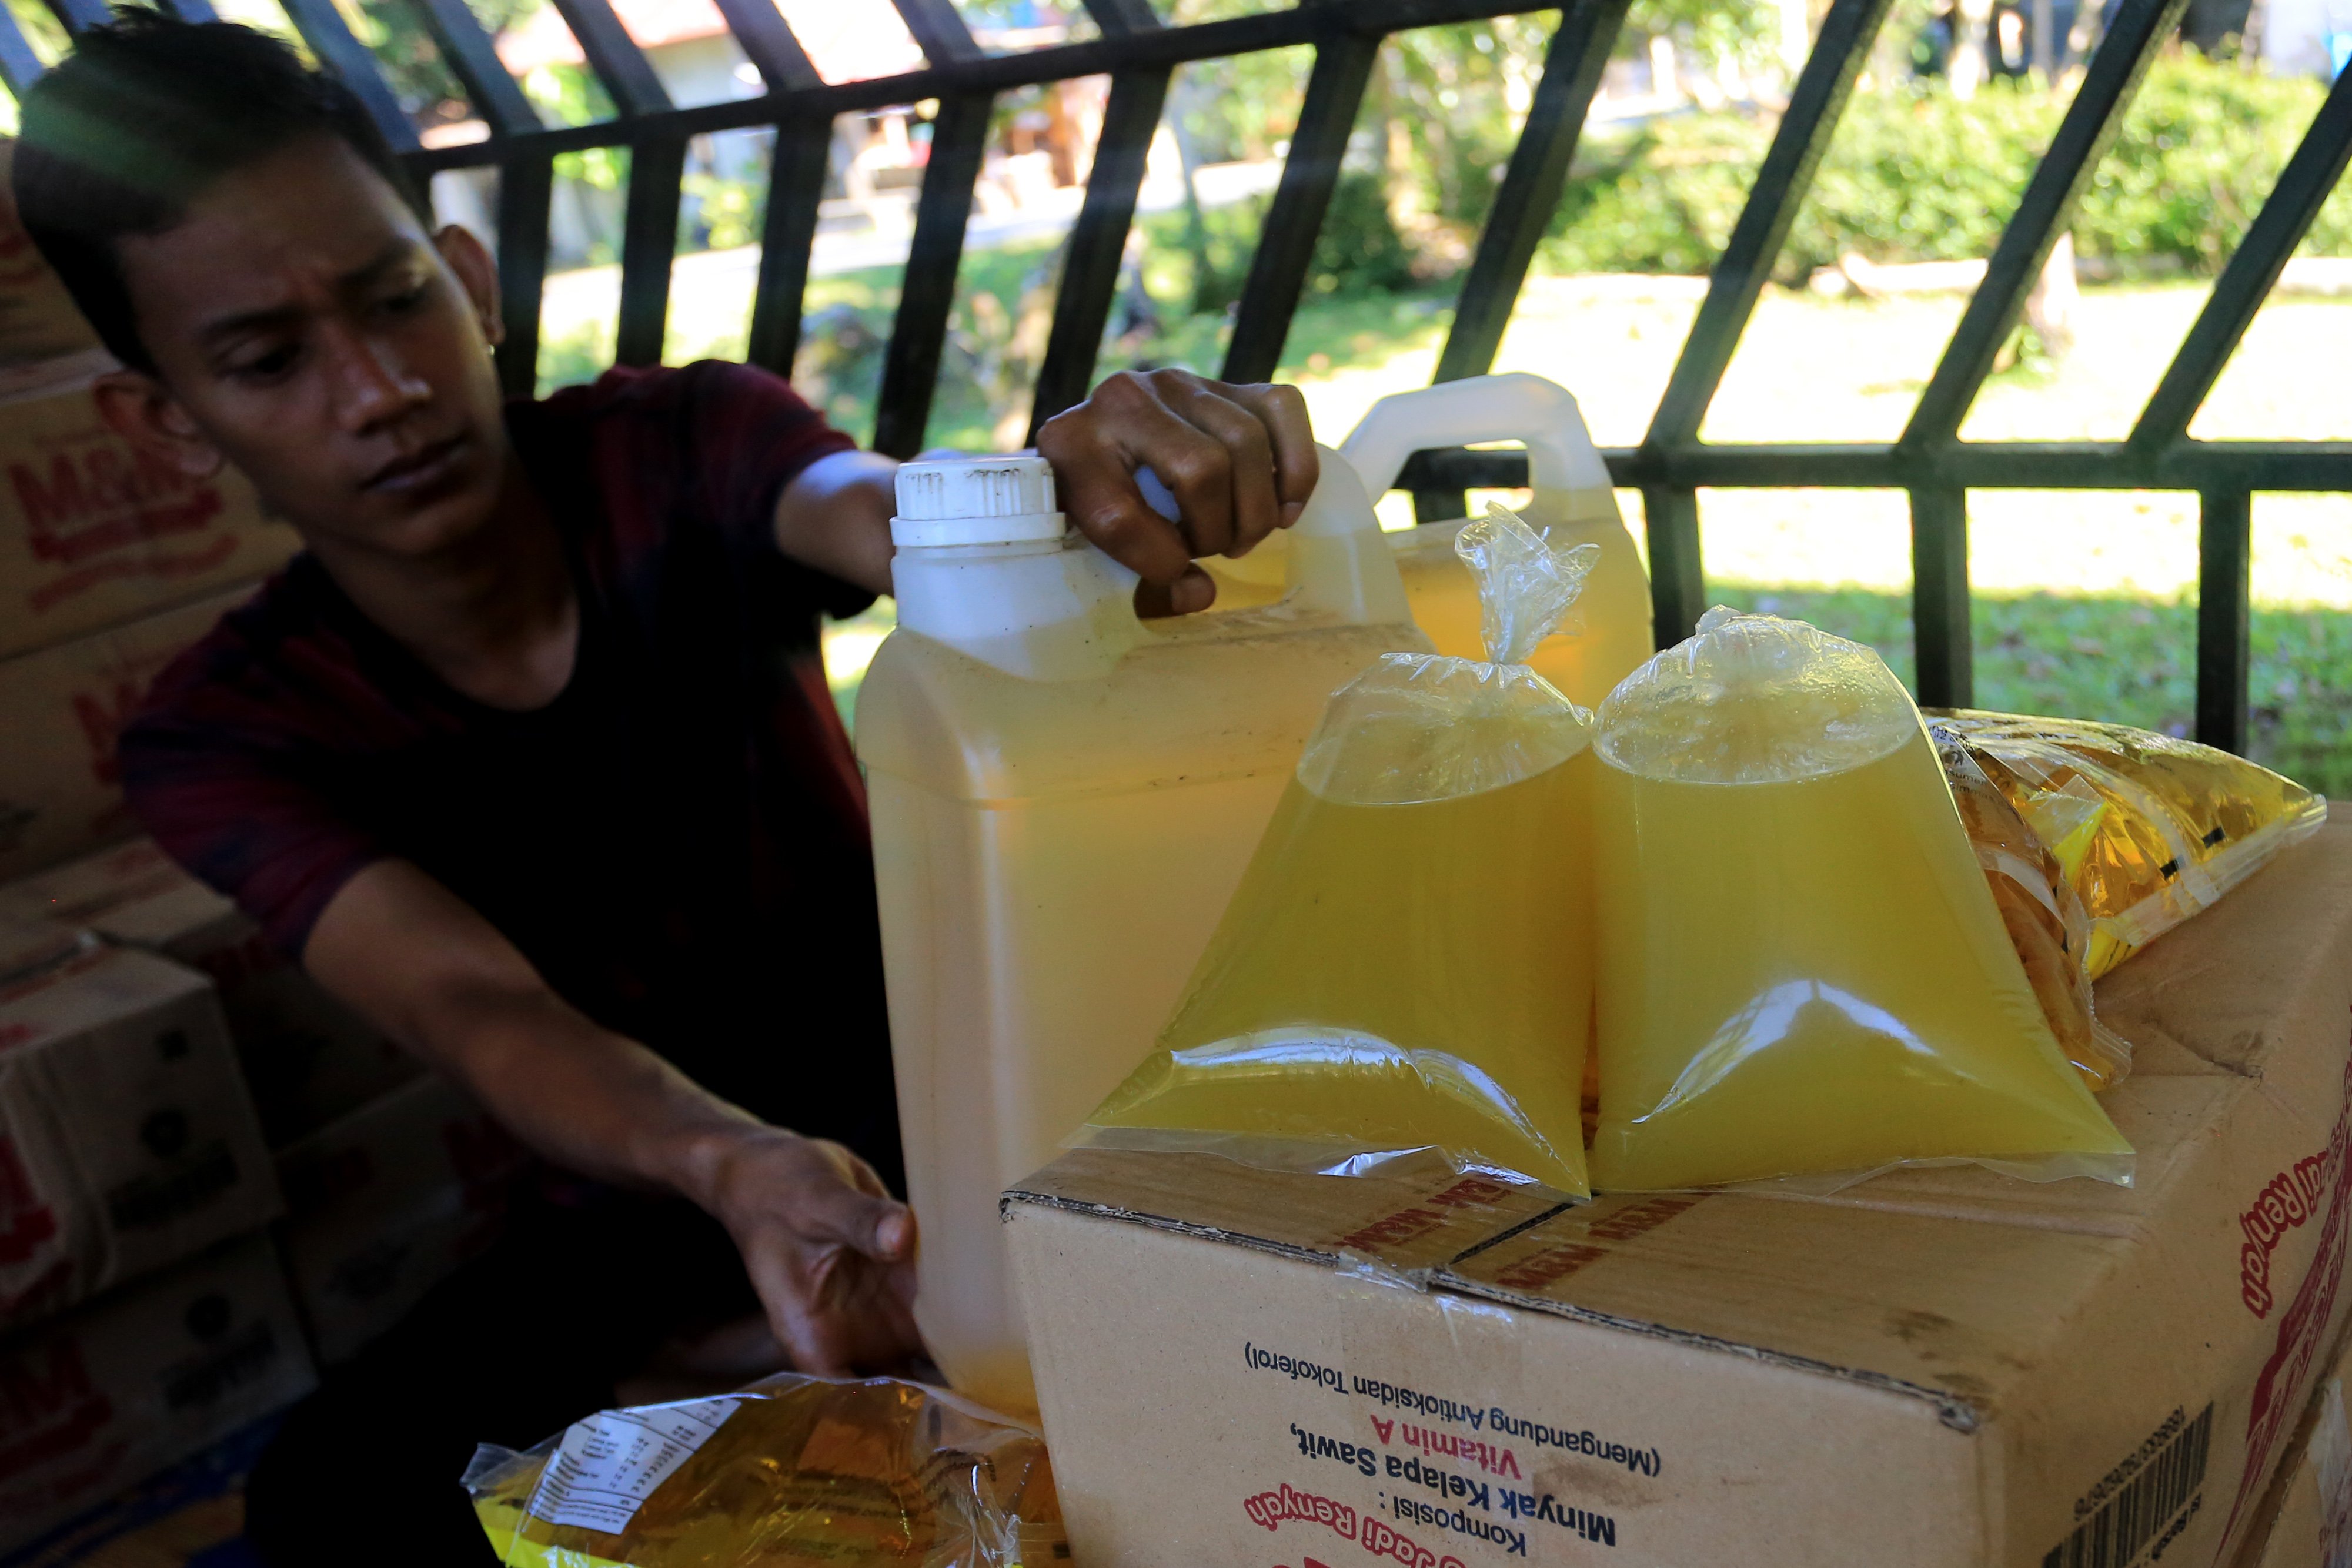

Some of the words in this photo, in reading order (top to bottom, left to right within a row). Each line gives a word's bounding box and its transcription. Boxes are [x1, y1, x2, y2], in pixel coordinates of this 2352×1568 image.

[2240, 1172, 2307, 1319] Renyah
[1244, 1342, 1348, 1395] Tokoferol)
[1354, 1375, 1484, 1431] Antioksidan
[1369, 1414, 1394, 1447] A
[1290, 1423, 1377, 1475] Sawit,
[1401, 1423, 1522, 1481] Vitamin
[1489, 1408, 1662, 1478] (Mengandung
[1244, 1483, 1357, 1541] Renyah
[1384, 1454, 1491, 1513] Kelapa
[1394, 1495, 1527, 1557] Komposisi
[1498, 1486, 1617, 1547] Minyak
